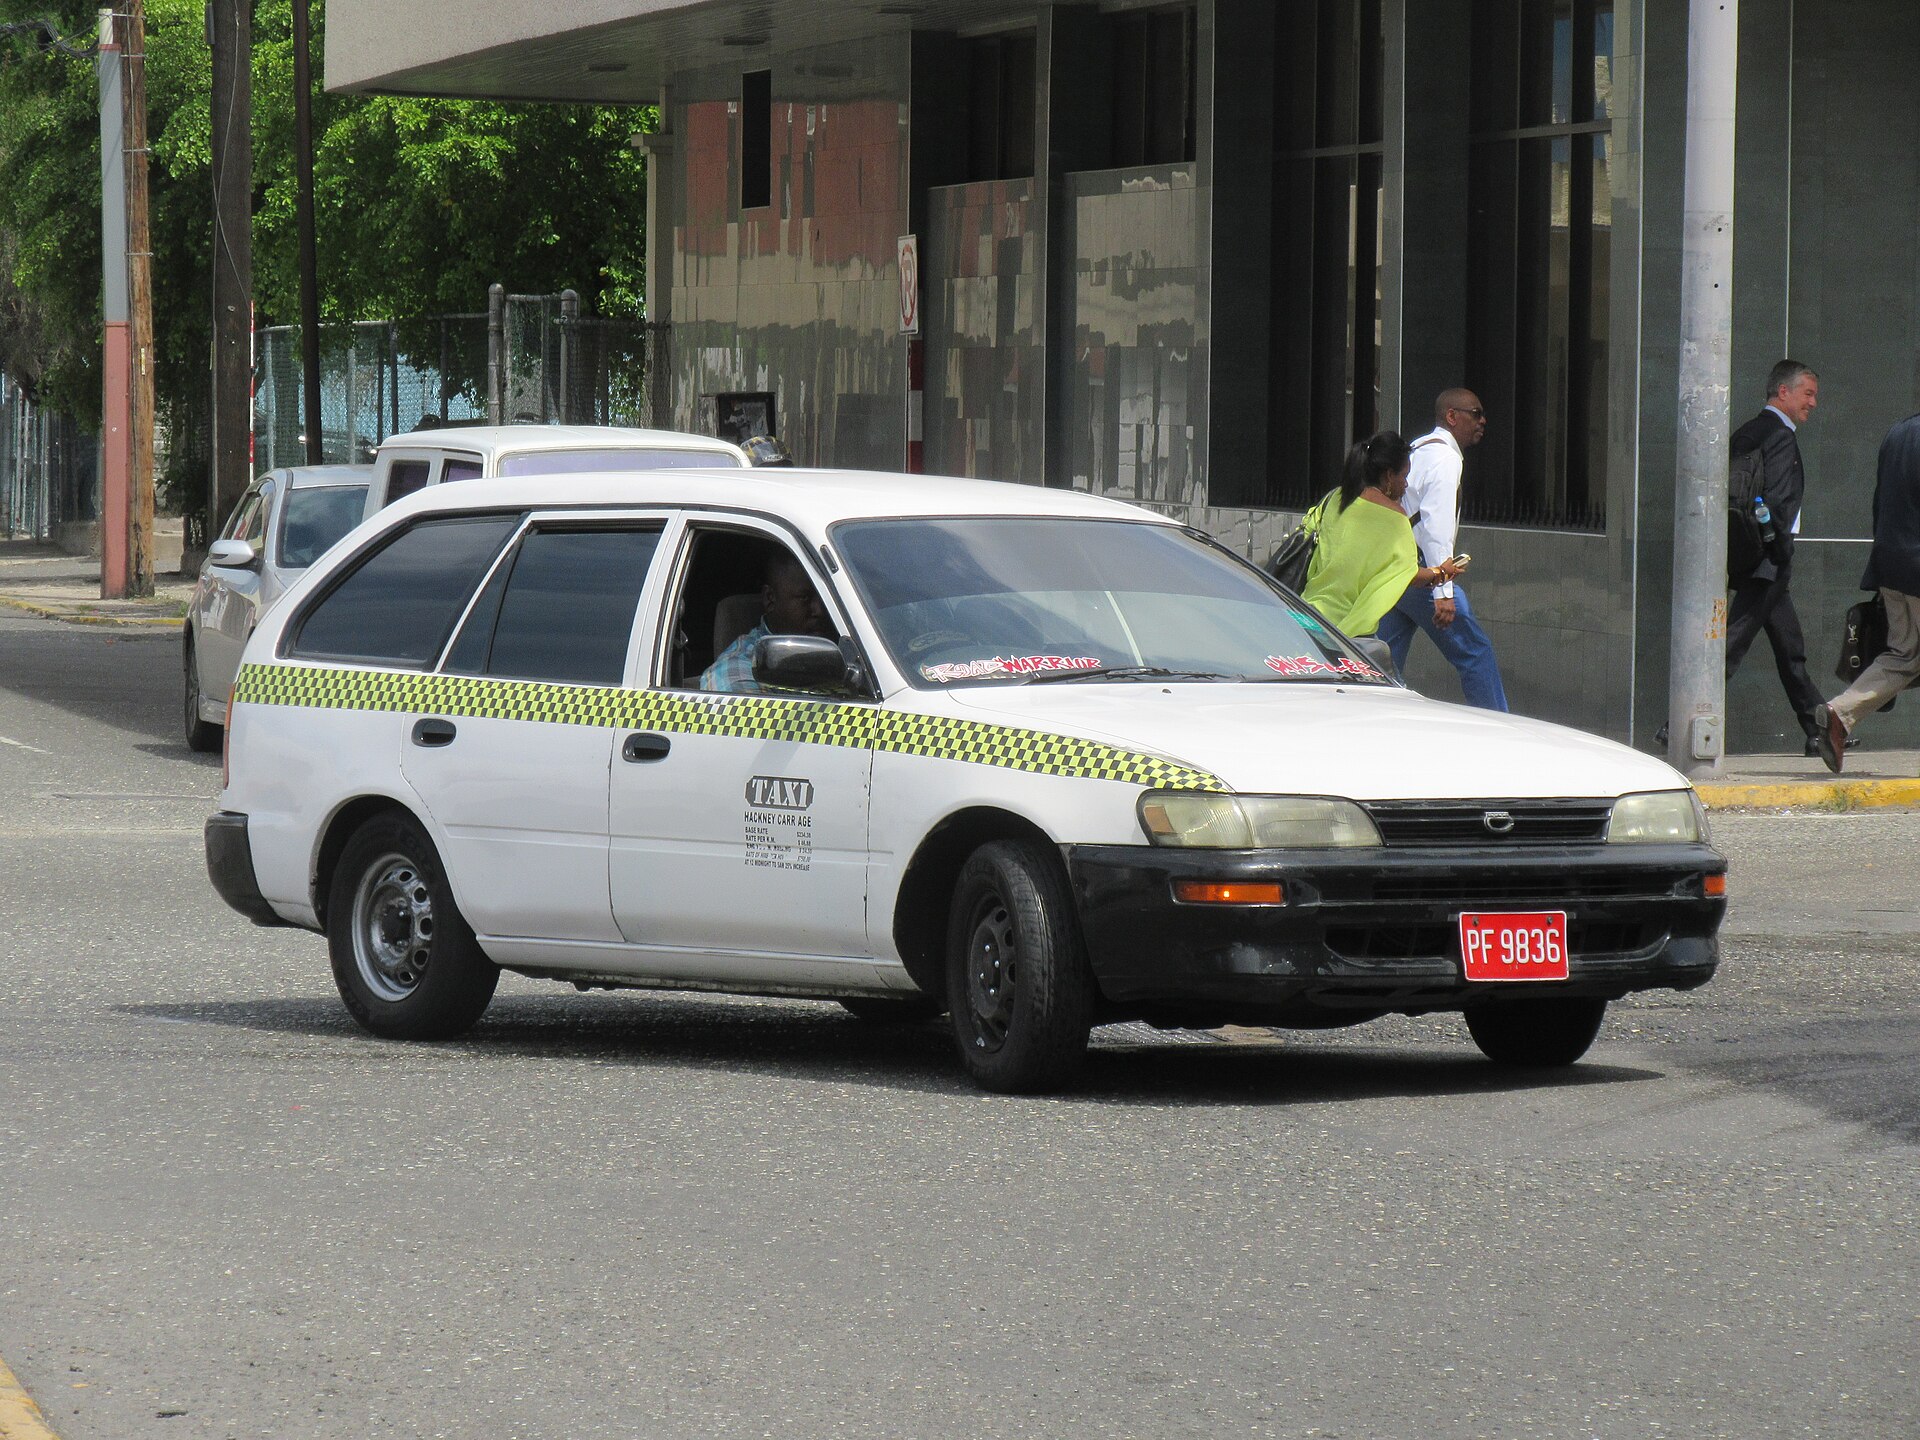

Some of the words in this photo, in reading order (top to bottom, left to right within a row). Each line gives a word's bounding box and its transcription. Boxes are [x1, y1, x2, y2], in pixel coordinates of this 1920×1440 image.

[927, 659, 1000, 683] ROAD
[995, 655, 1101, 674] WARRIOR
[752, 778, 810, 808] TAXI
[744, 811, 776, 824] HACKNEY
[745, 834, 756, 842] RATE
[757, 827, 768, 835] RATE
[1467, 929, 1494, 964] PF
[1500, 928, 1561, 964] 9836
